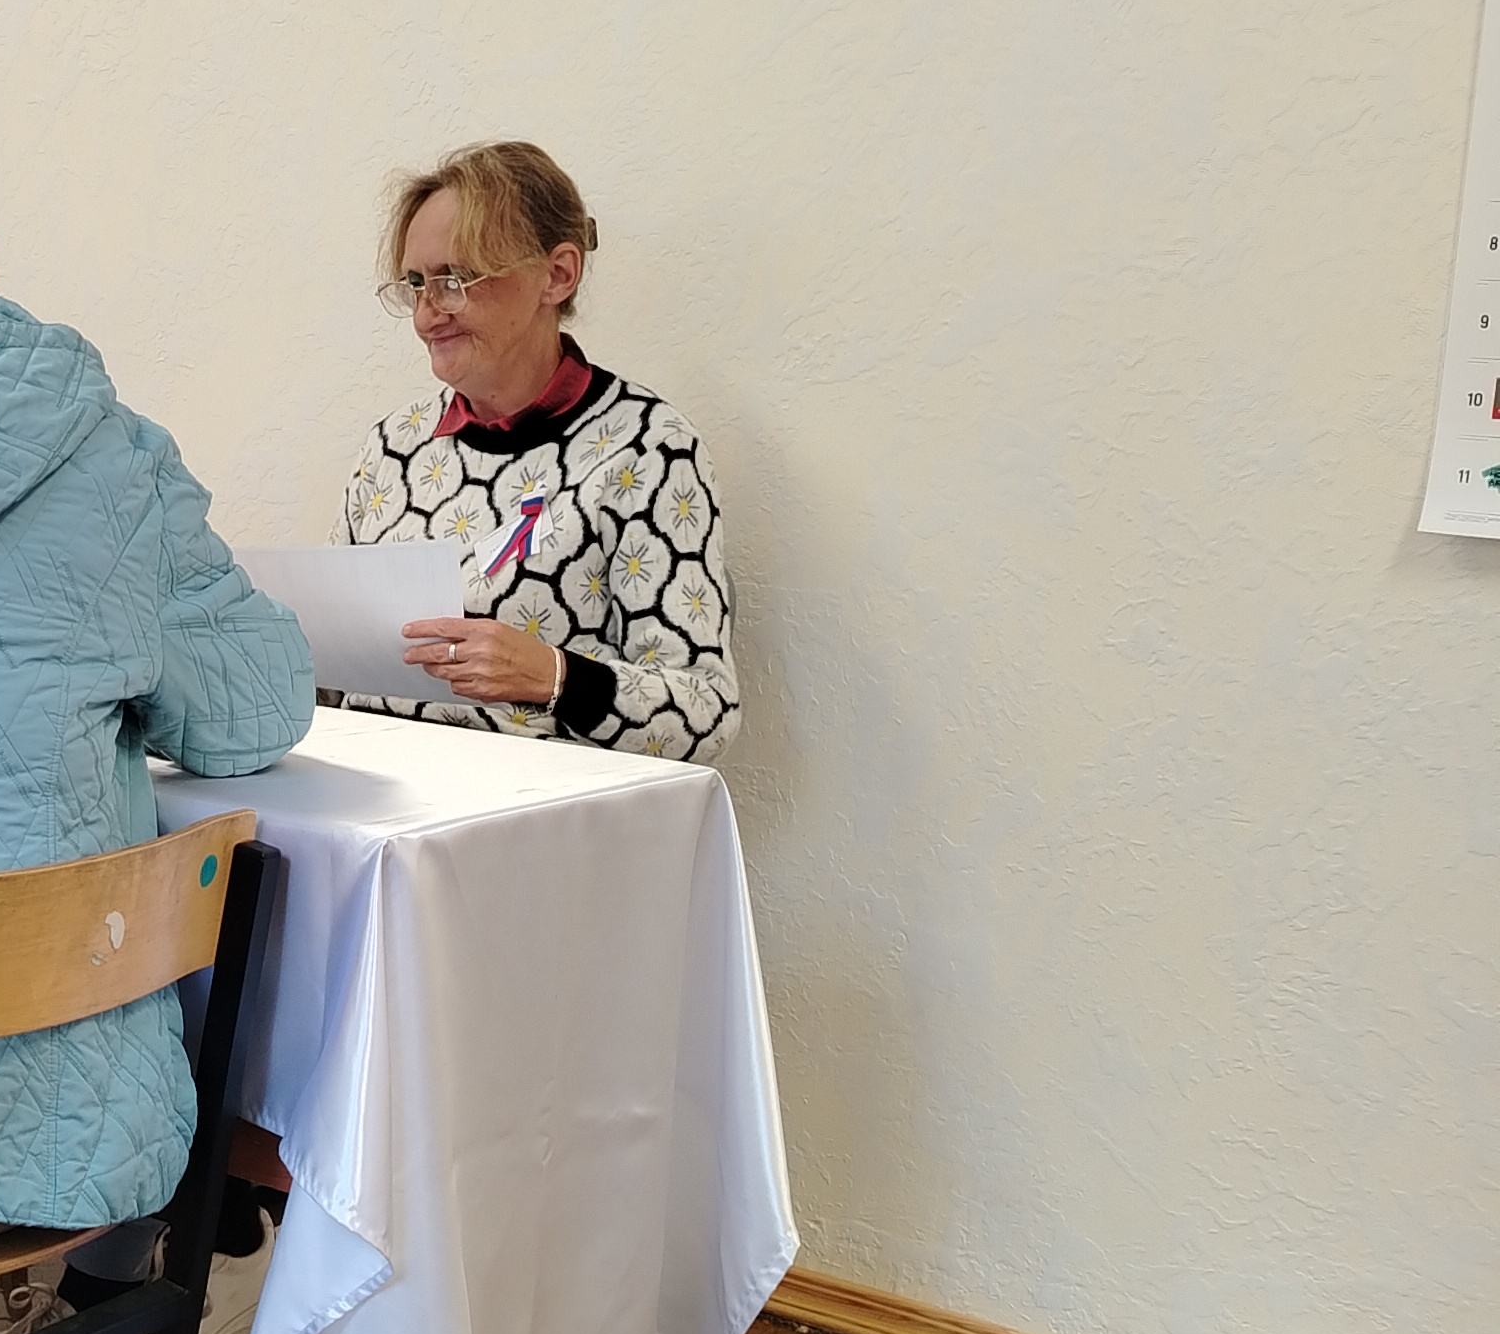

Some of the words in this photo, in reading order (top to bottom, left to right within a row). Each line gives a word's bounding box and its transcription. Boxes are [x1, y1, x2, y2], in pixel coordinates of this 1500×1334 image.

[1489, 236, 1498, 251] 8
[1480, 314, 1489, 329] 9
[1467, 392, 1483, 407] 10
[1458, 469, 1471, 484] 11
